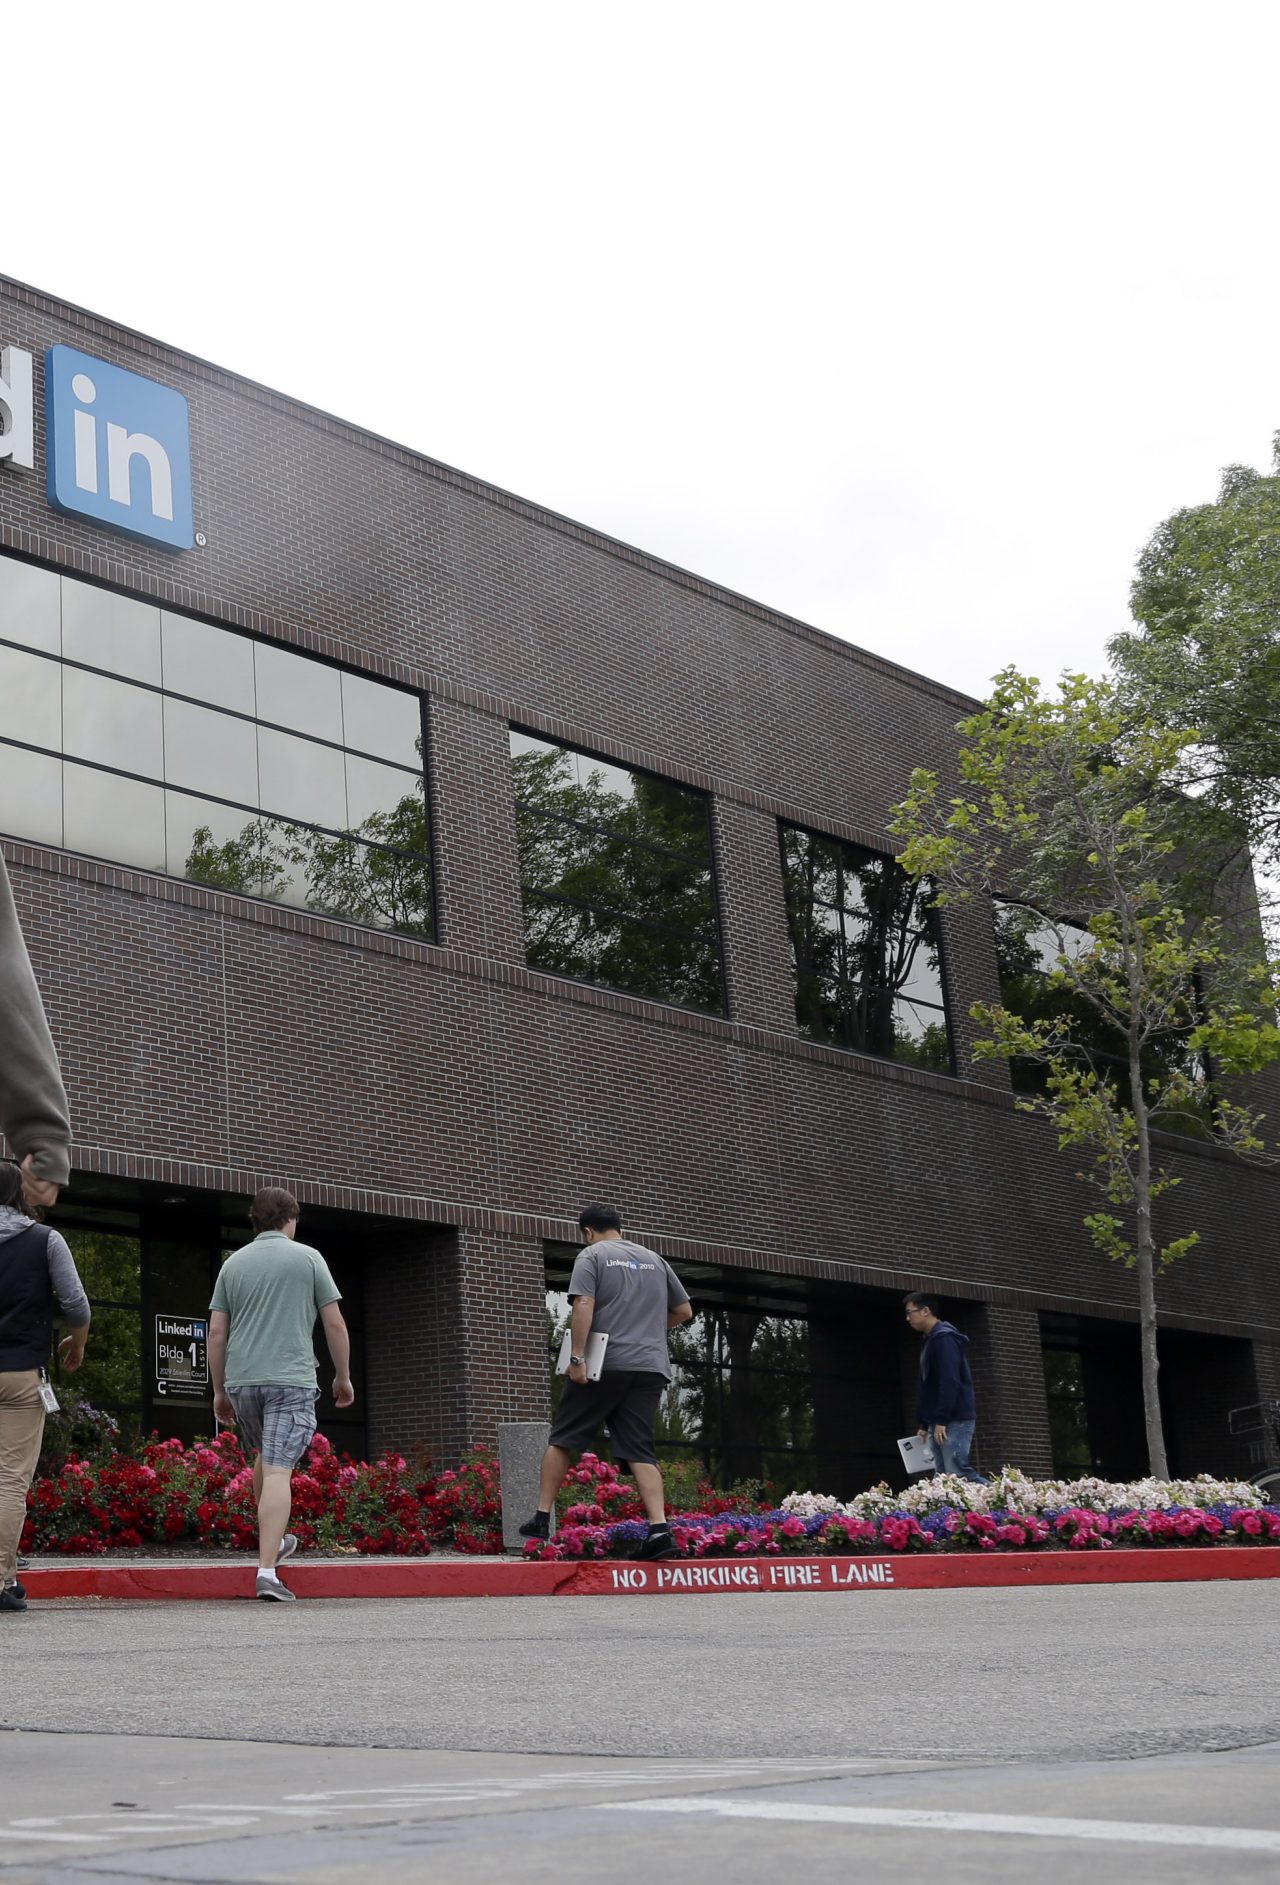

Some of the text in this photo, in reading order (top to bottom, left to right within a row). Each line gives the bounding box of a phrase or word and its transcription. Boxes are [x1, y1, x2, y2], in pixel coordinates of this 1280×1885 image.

[159, 1342, 197, 1367] Bldg 1
[611, 1562, 895, 1589] NO PARKING FIRE LANE
